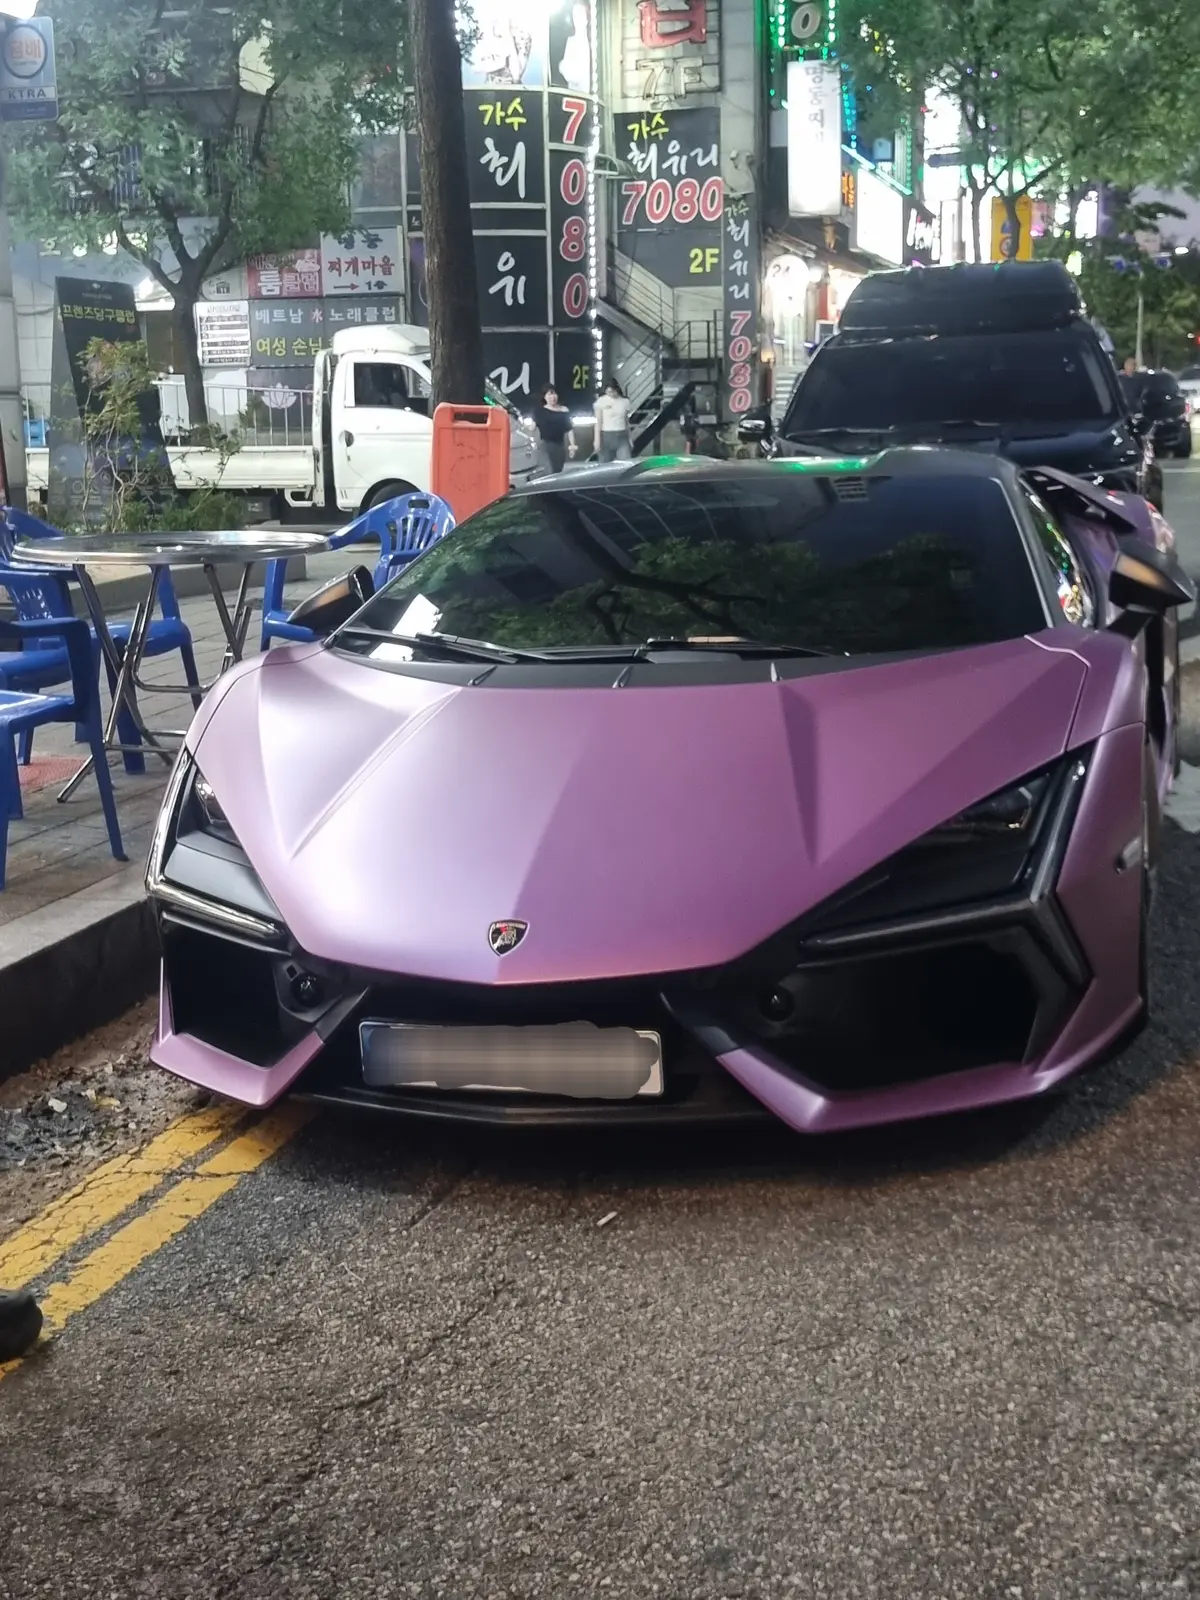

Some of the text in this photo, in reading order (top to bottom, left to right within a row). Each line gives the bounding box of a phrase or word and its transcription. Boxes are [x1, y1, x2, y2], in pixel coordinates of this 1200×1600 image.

[635, 56, 704, 100] 7F
[8, 87, 47, 99] KTRA
[478, 97, 527, 131] 가수
[627, 112, 670, 141] 가수
[626, 139, 718, 180] 최유리
[560, 97, 588, 318] 7080
[620, 175, 725, 225] 7080
[724, 200, 750, 218] 가수
[328, 254, 396, 278] 찌개마을
[688, 247, 720, 274] 2F
[726, 218, 750, 299] 최유리
[255, 308, 303, 325] 베트남
[328, 306, 396, 323] 노래클럽
[256, 336, 286, 357] 여성
[291, 337, 322, 356] 손님
[728, 310, 752, 413] 7080
[572, 364, 590, 390] 2F
